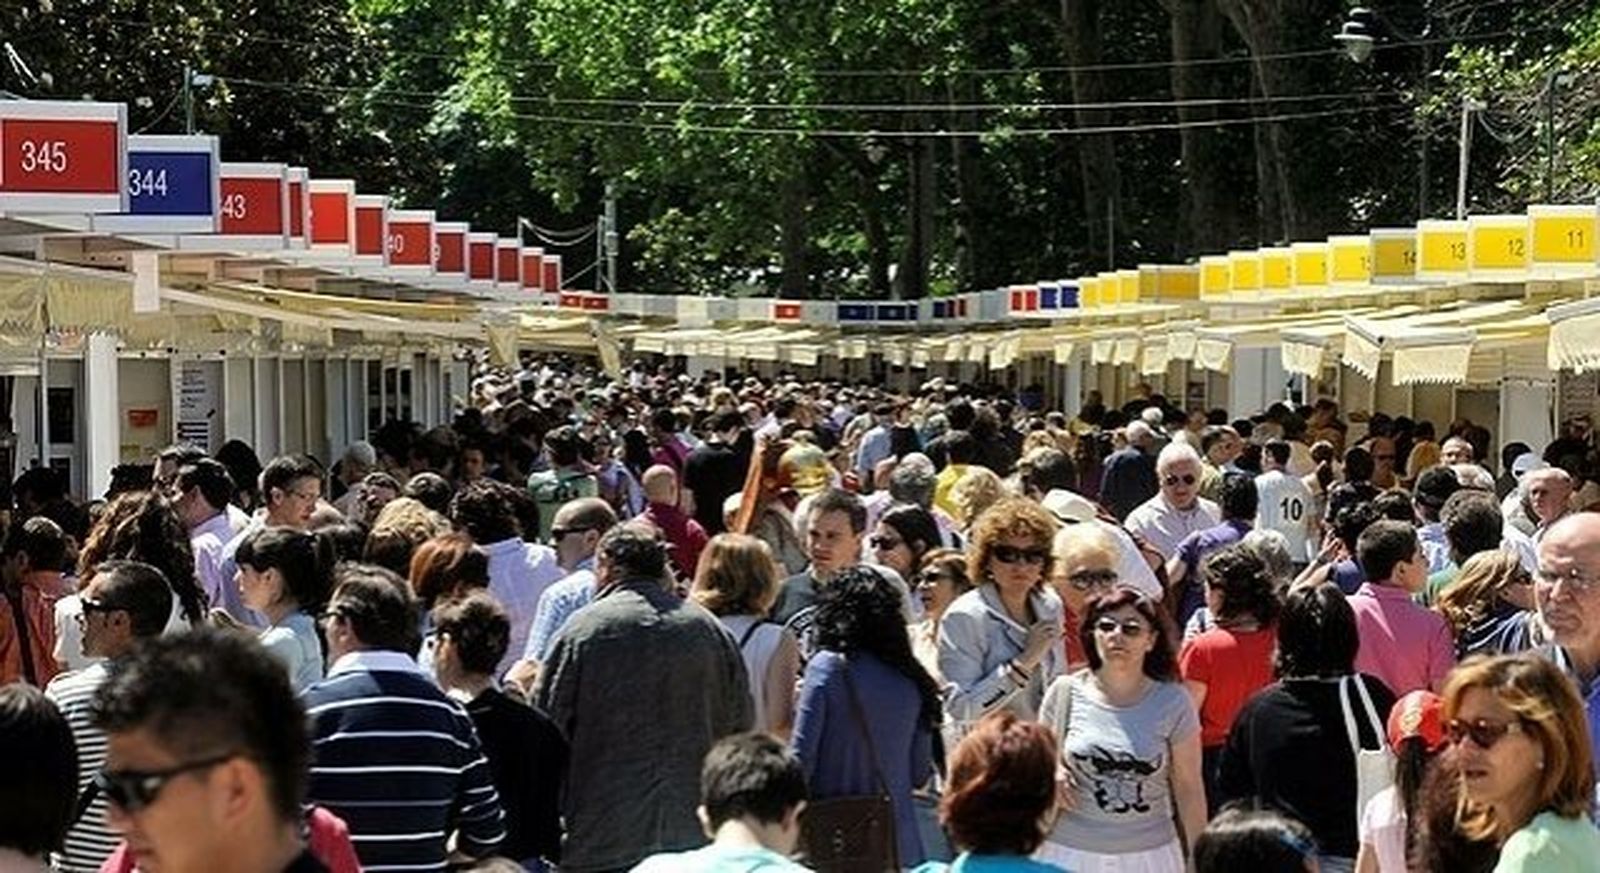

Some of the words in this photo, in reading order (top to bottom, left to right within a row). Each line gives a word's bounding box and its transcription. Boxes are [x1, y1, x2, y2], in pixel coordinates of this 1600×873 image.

[21, 140, 67, 172] 345
[128, 169, 168, 197] 344
[221, 193, 246, 219] 43
[1508, 238, 1525, 257] 12
[1567, 230, 1584, 248] 11
[1451, 242, 1466, 261] 13
[1280, 497, 1303, 521] 10
